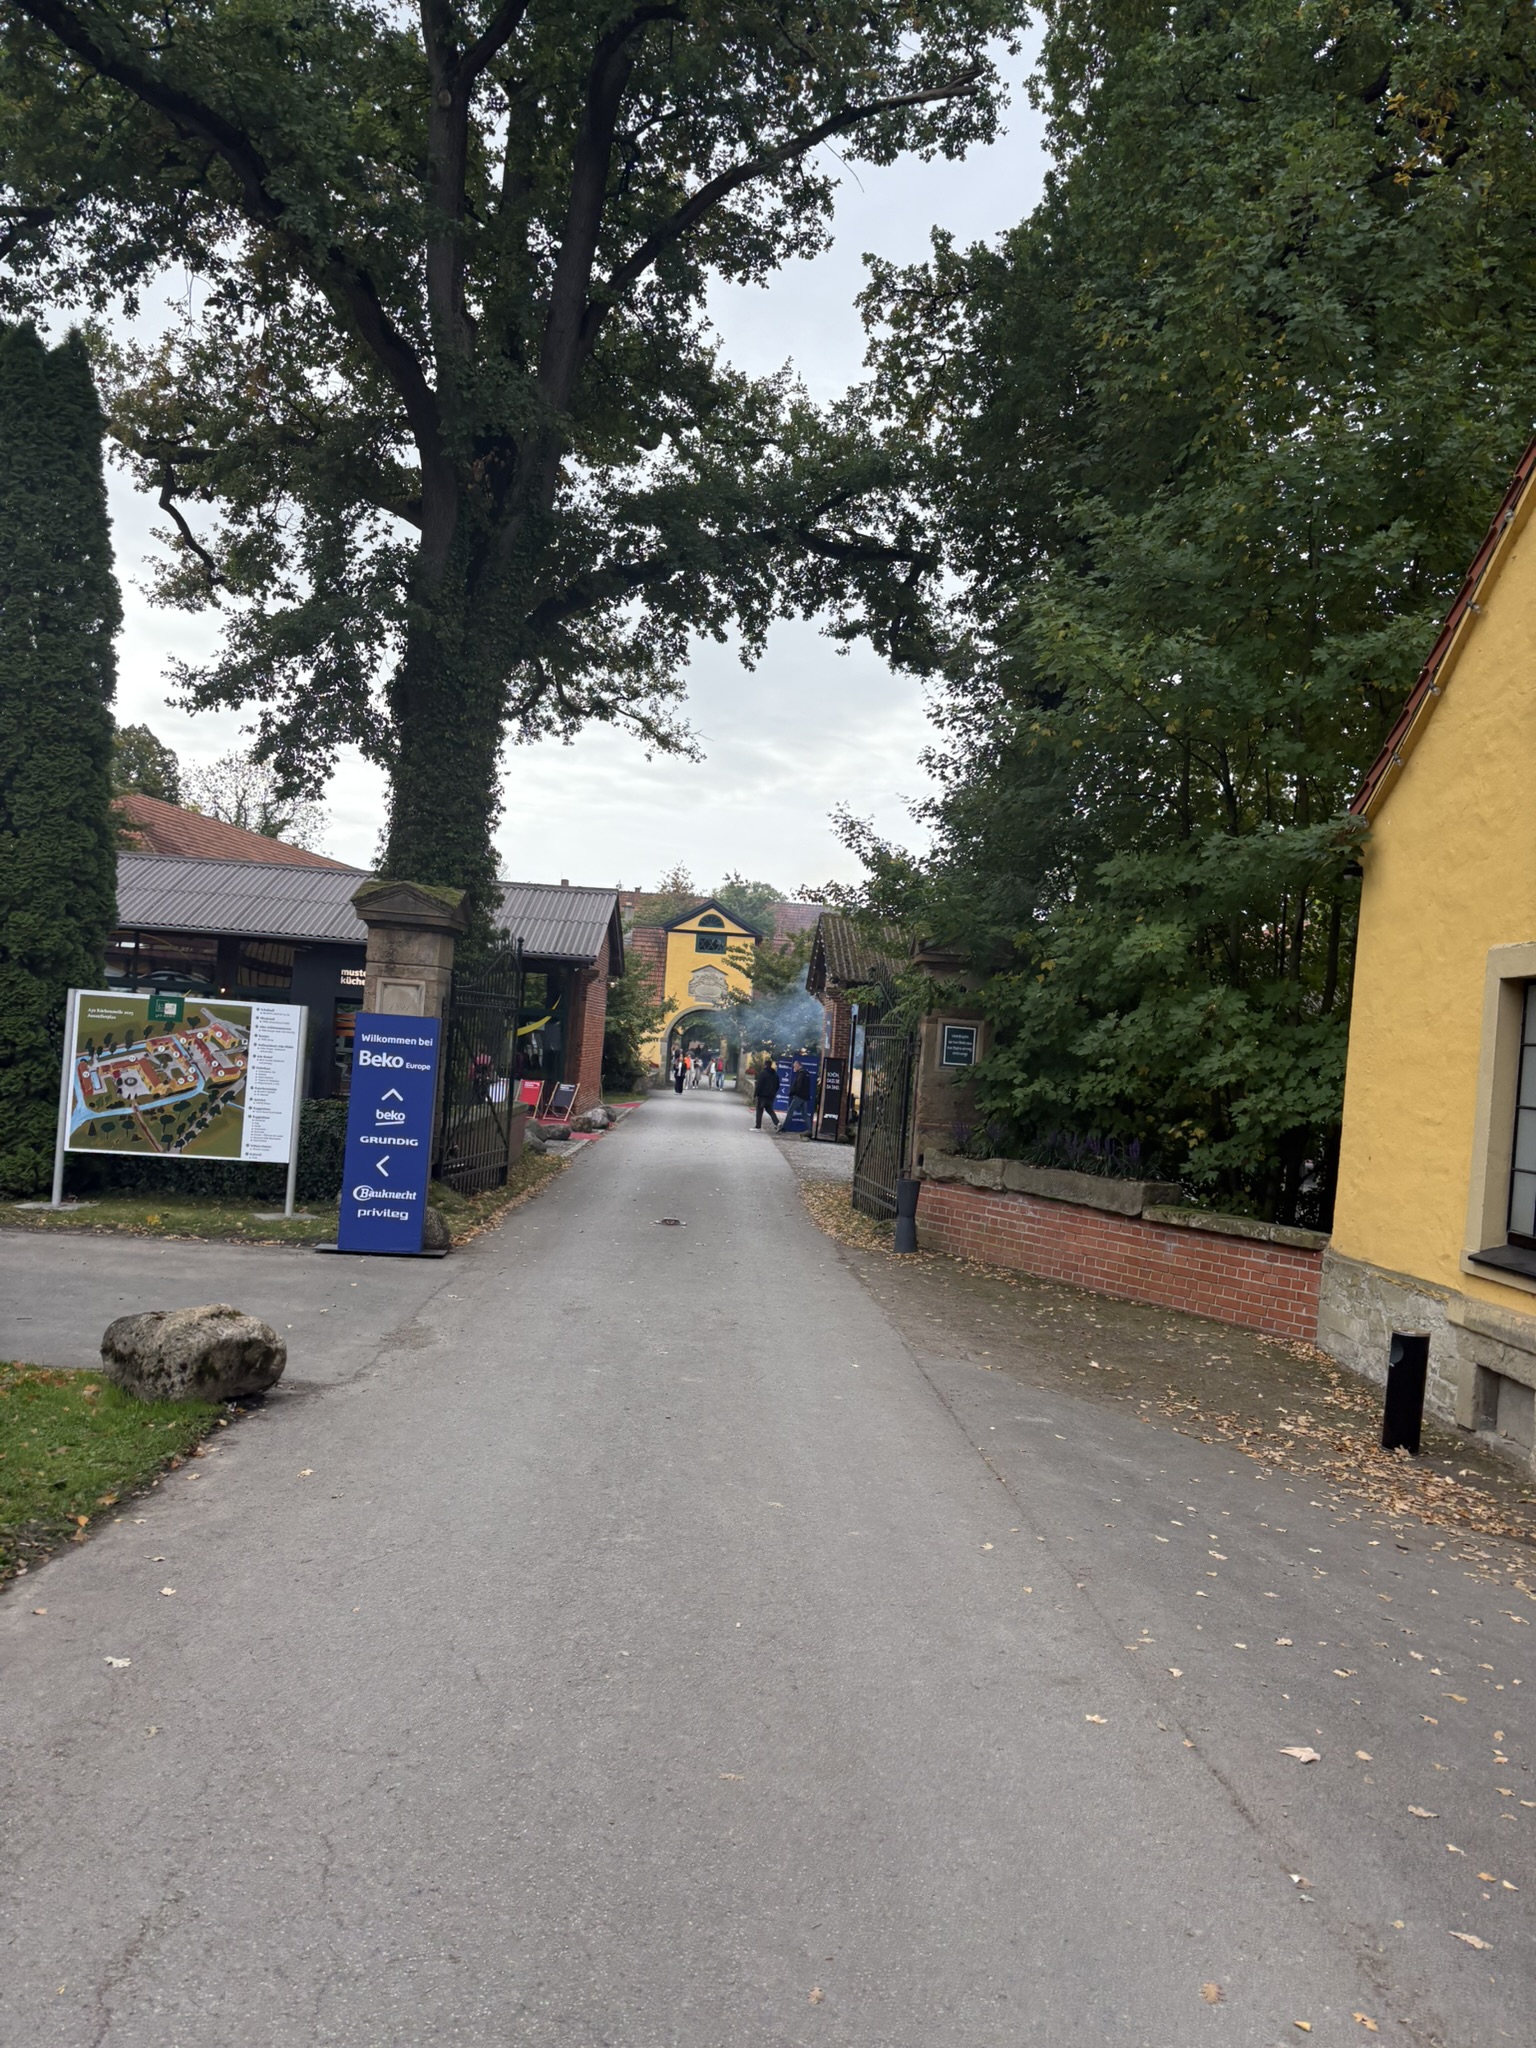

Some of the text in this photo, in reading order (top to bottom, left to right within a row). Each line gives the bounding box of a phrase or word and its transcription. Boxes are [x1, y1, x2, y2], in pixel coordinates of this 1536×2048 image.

[361, 1033, 434, 1046] Wilkommen bei
[359, 1049, 431, 1071] Beko Europe
[376, 1109, 406, 1121] beko
[360, 1135, 419, 1146] GRUNDIG
[354, 1185, 417, 1201] Bauknecht
[357, 1208, 409, 1221] privileg
